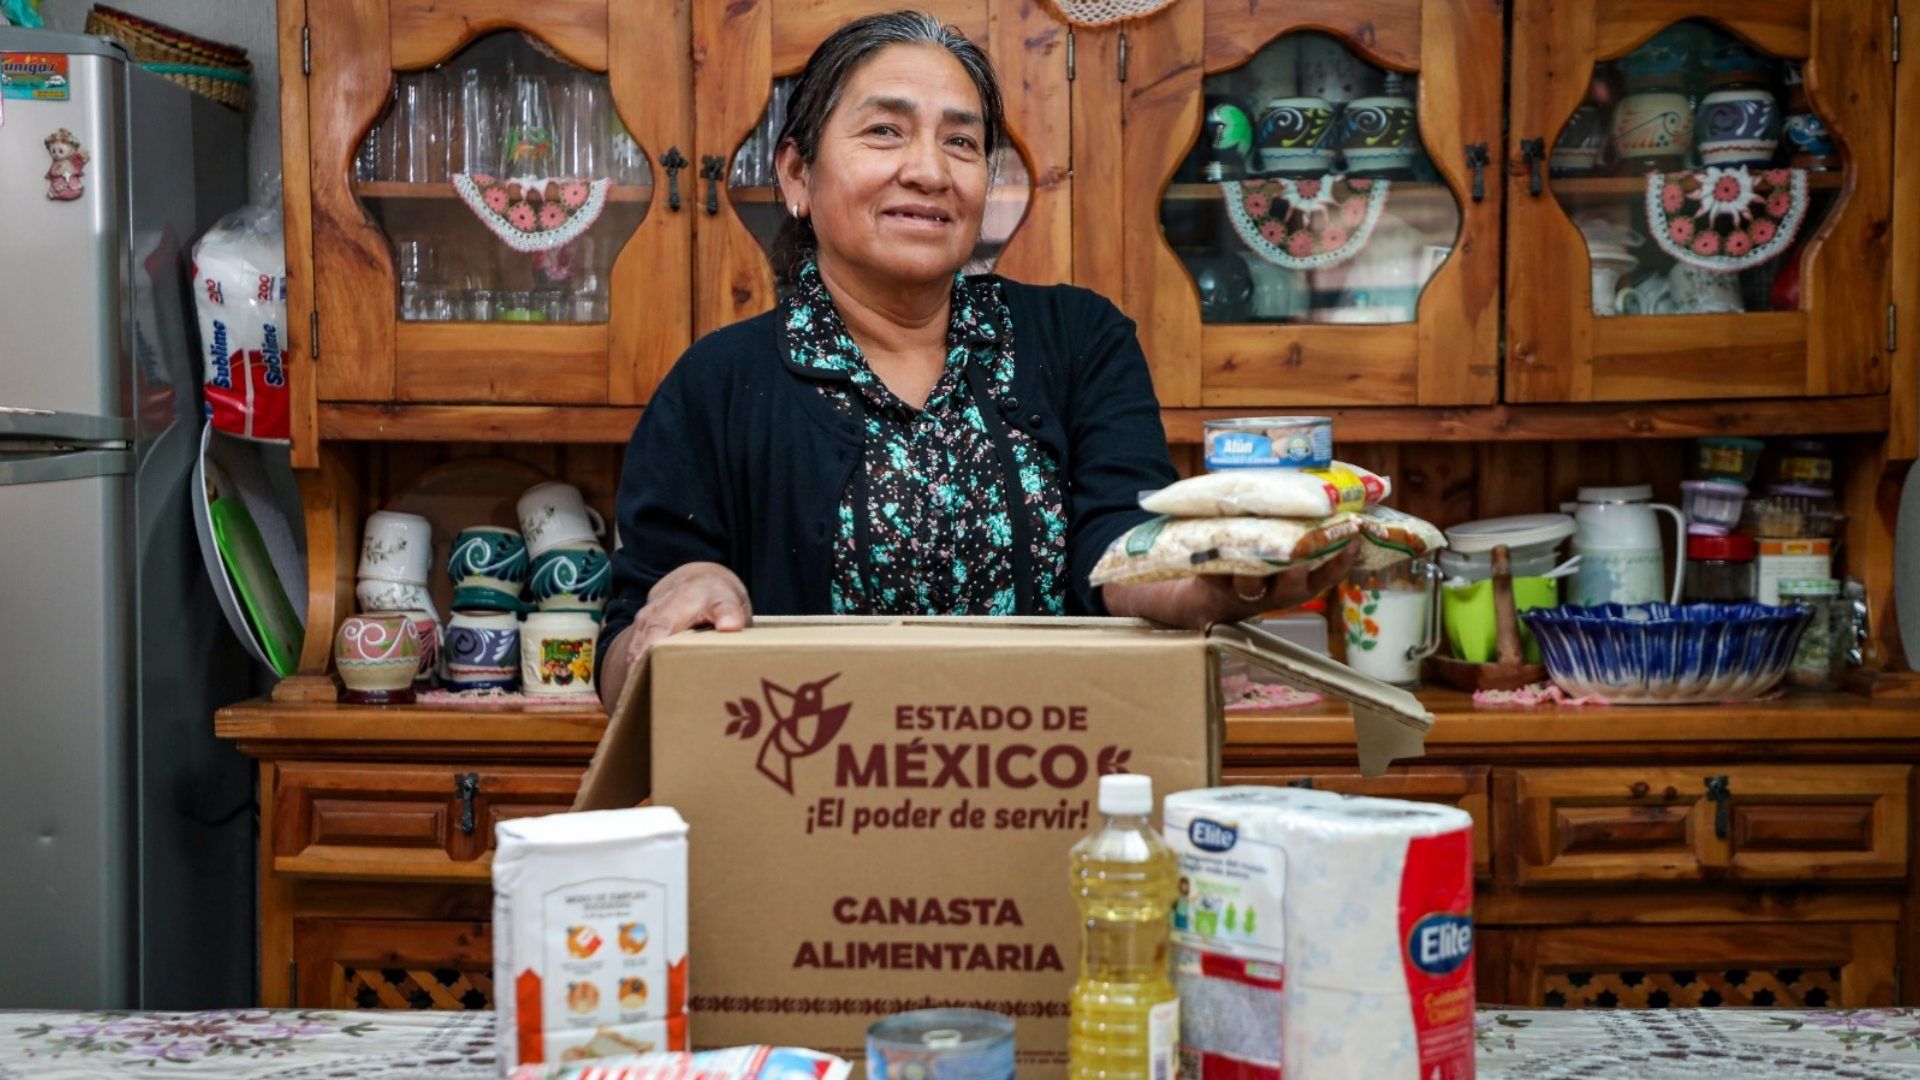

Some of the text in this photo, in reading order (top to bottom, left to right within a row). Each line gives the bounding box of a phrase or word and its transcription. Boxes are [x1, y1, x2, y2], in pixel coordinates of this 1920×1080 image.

[257, 273, 271, 303] 200
[210, 319, 231, 388] Sublime
[261, 323, 284, 386] Sublime
[895, 705, 1088, 732] ESTADO DE
[835, 736, 1090, 790] MÉXICO
[806, 797, 1090, 835] ¡El poder de servir!
[1192, 821, 1235, 850] Elite
[833, 896, 1024, 927] CANASTA
[792, 941, 1066, 973] ALIMENTARIA
[1421, 922, 1472, 964] Elite
